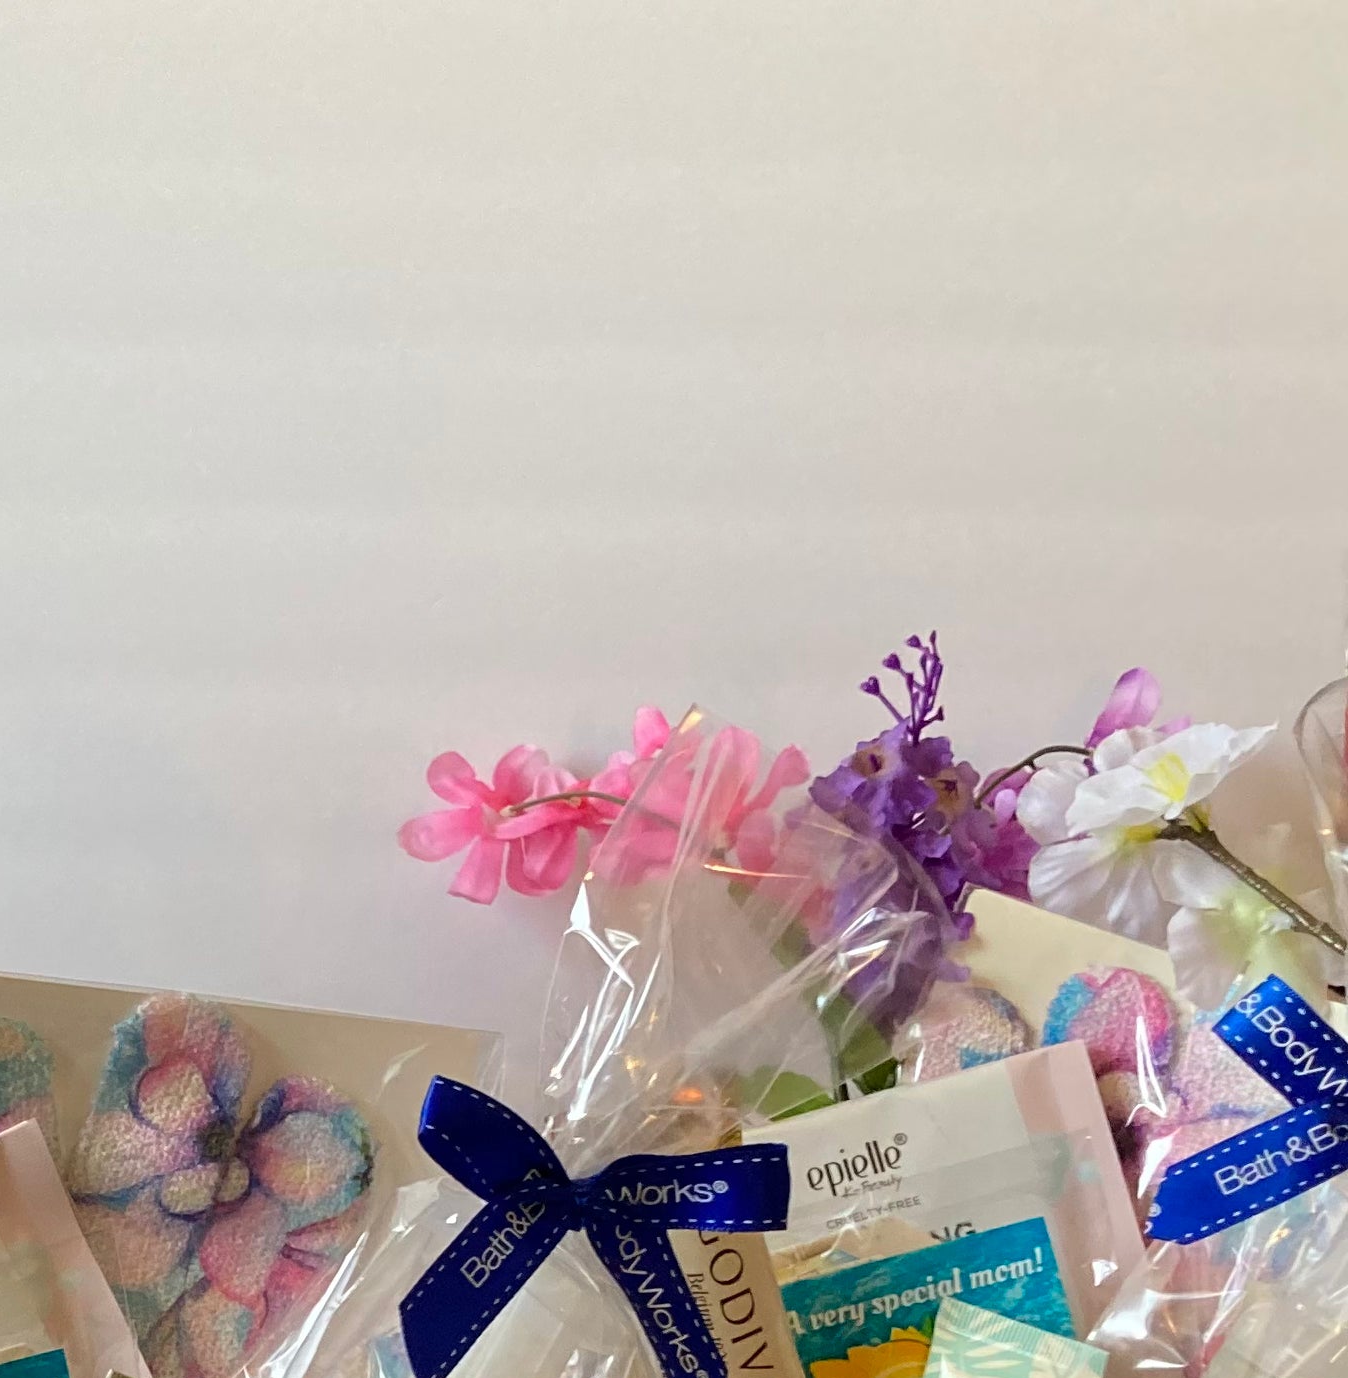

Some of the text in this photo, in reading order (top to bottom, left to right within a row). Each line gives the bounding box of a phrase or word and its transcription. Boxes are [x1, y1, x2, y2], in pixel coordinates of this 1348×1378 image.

[825, 1195, 922, 1230] CRUELTY-FREE
[786, 1246, 1044, 1335] A very special mom!
